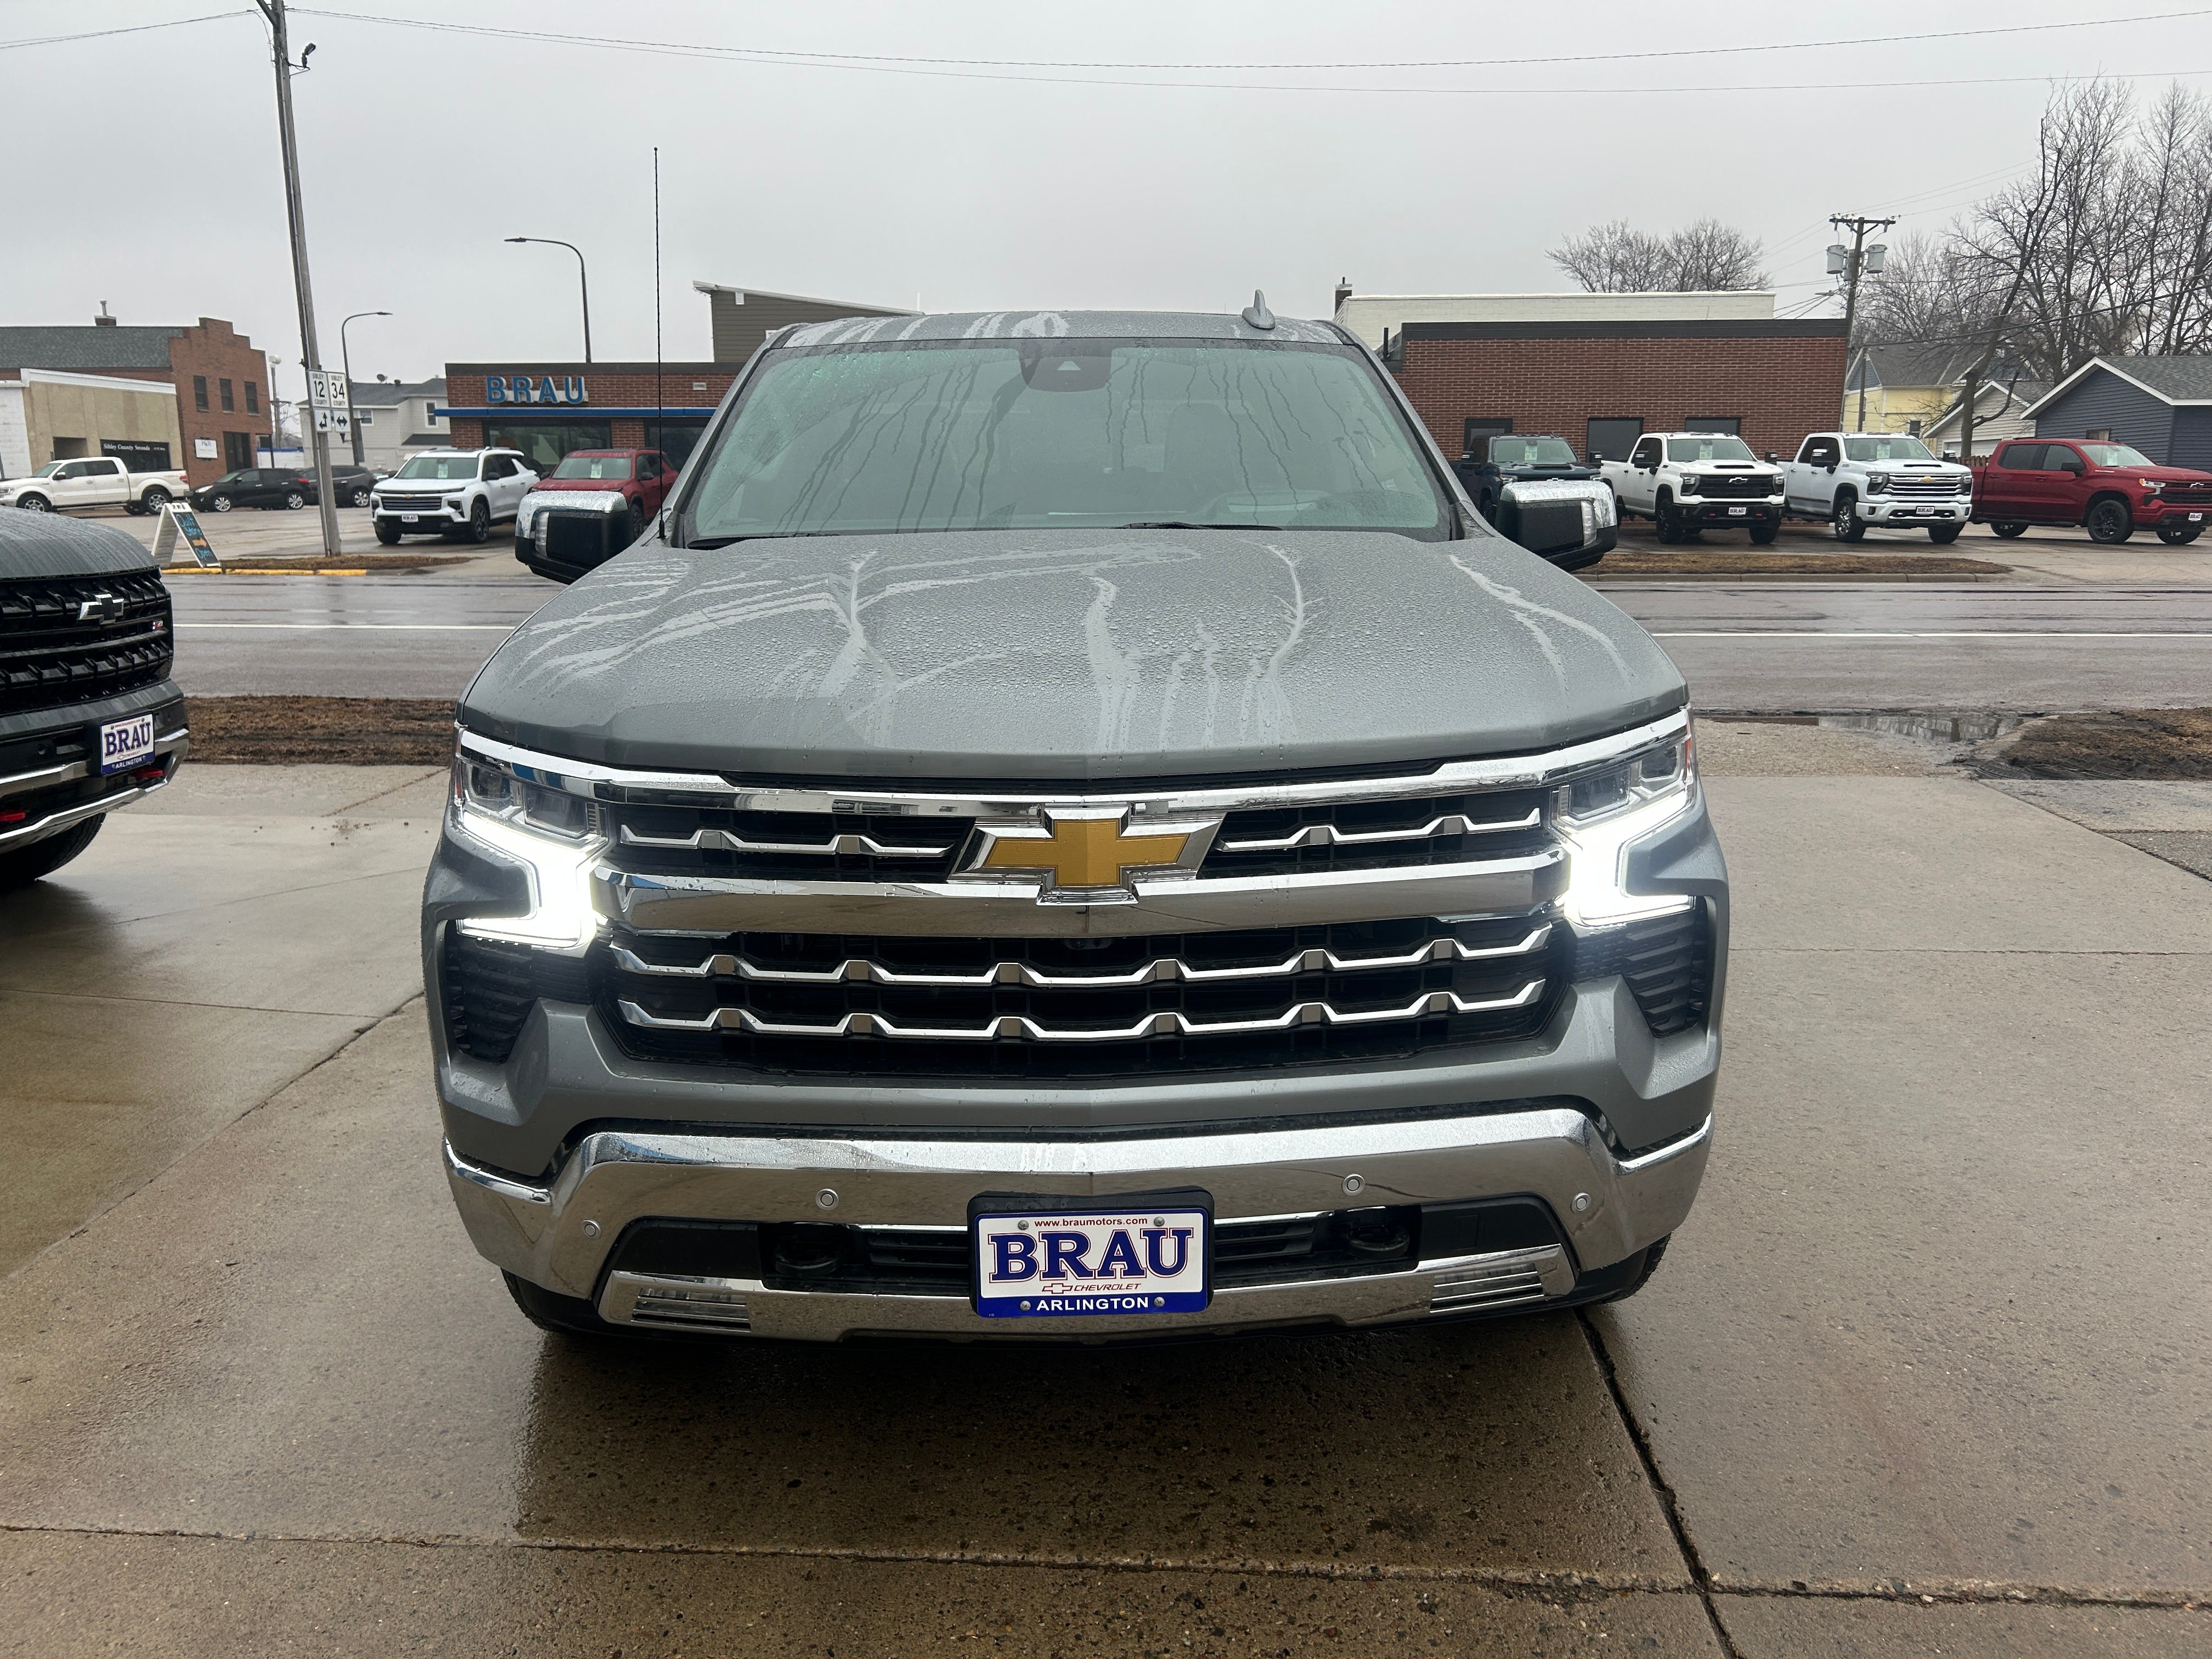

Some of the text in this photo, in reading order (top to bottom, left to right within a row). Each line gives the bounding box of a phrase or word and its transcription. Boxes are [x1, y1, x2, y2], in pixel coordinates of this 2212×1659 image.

[314, 380, 325, 398] 12
[331, 382, 345, 399] 34
[487, 376, 585, 404] BRAU
[195, 548, 213, 560] Open
[104, 721, 151, 758] BRAU
[115, 757, 142, 769] ARLINGTON
[1034, 1216, 1148, 1227] www.braumotors.com
[988, 1227, 1194, 1283] BRAU
[1074, 1283, 1142, 1292] CHEVROLET
[1036, 1297, 1149, 1312] ARLINGTON
